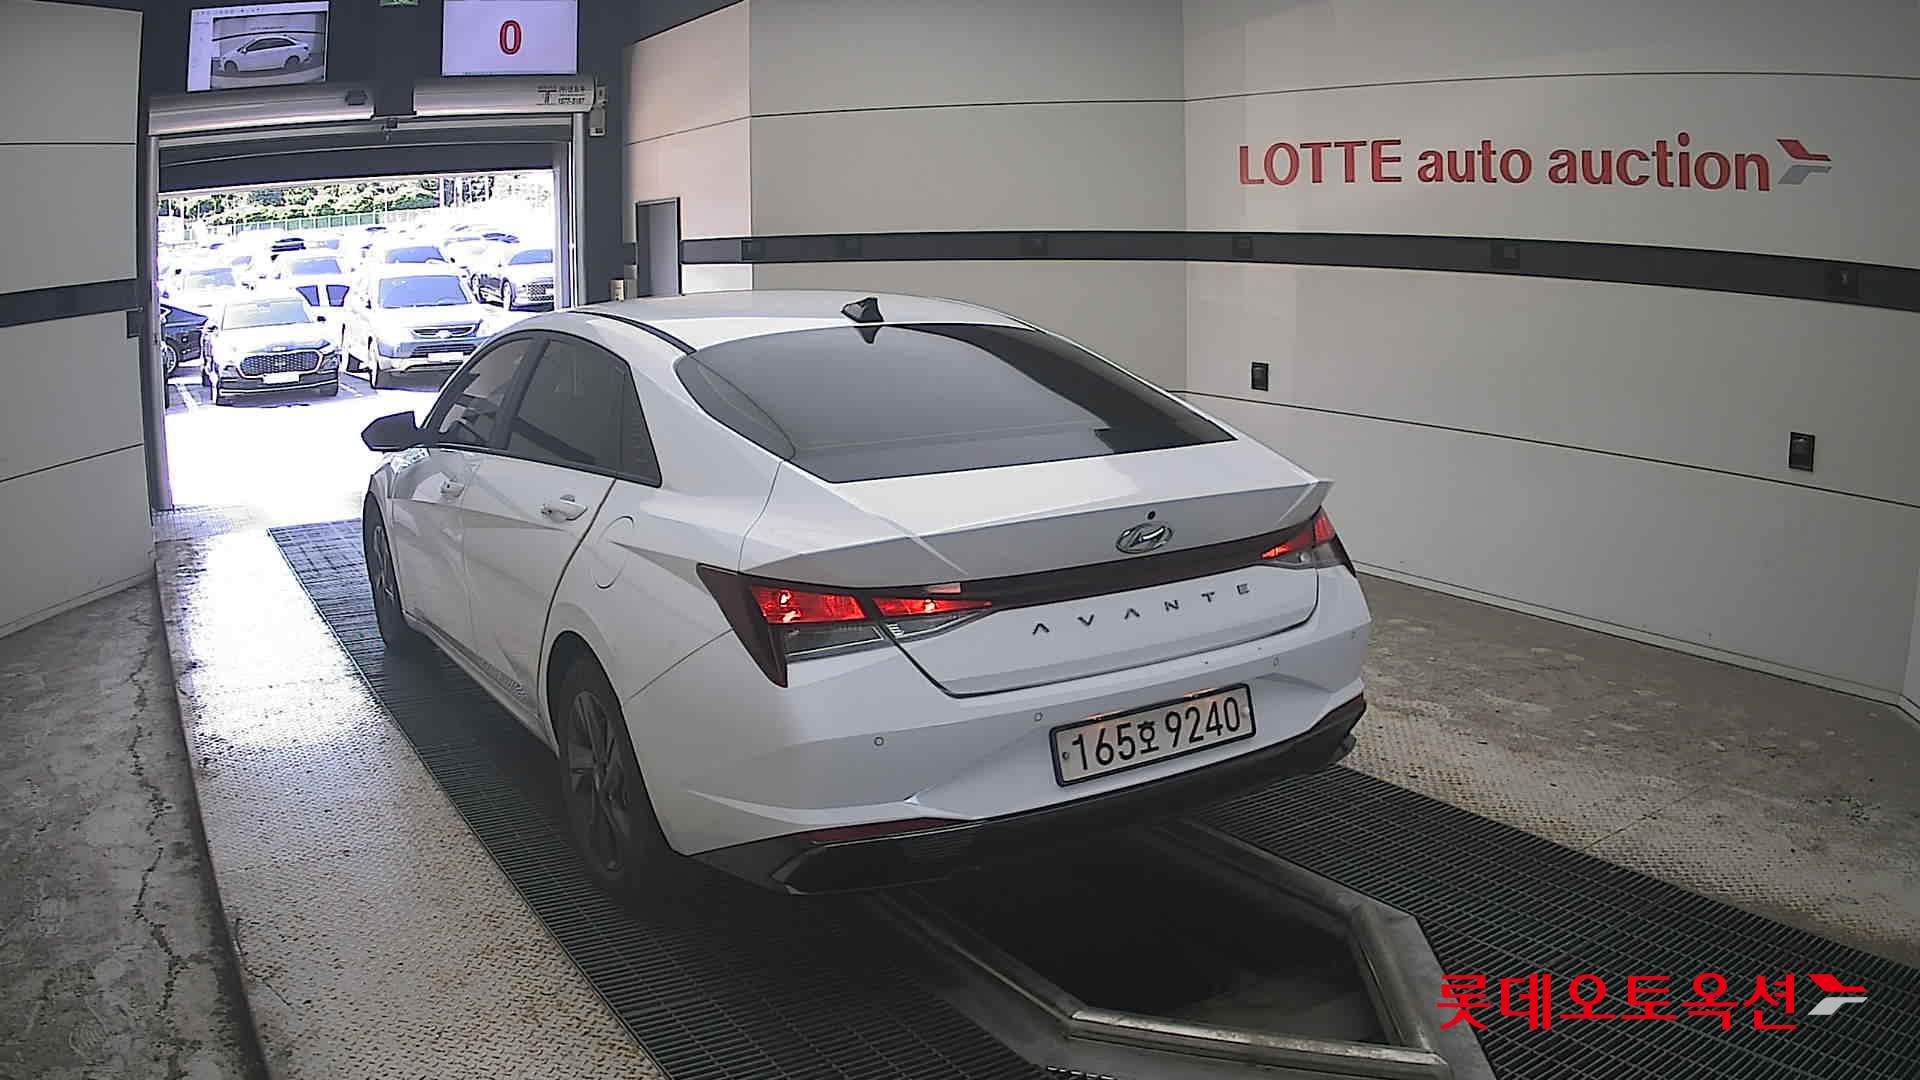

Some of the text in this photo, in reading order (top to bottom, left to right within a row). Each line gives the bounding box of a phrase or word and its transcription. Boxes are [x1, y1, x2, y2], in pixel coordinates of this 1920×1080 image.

[499, 20, 522, 55] 0
[1239, 132, 1771, 192] LOTTE auto auction
[1032, 583, 1249, 635] AVANTE
[1071, 696, 1241, 771] 165호 9240
